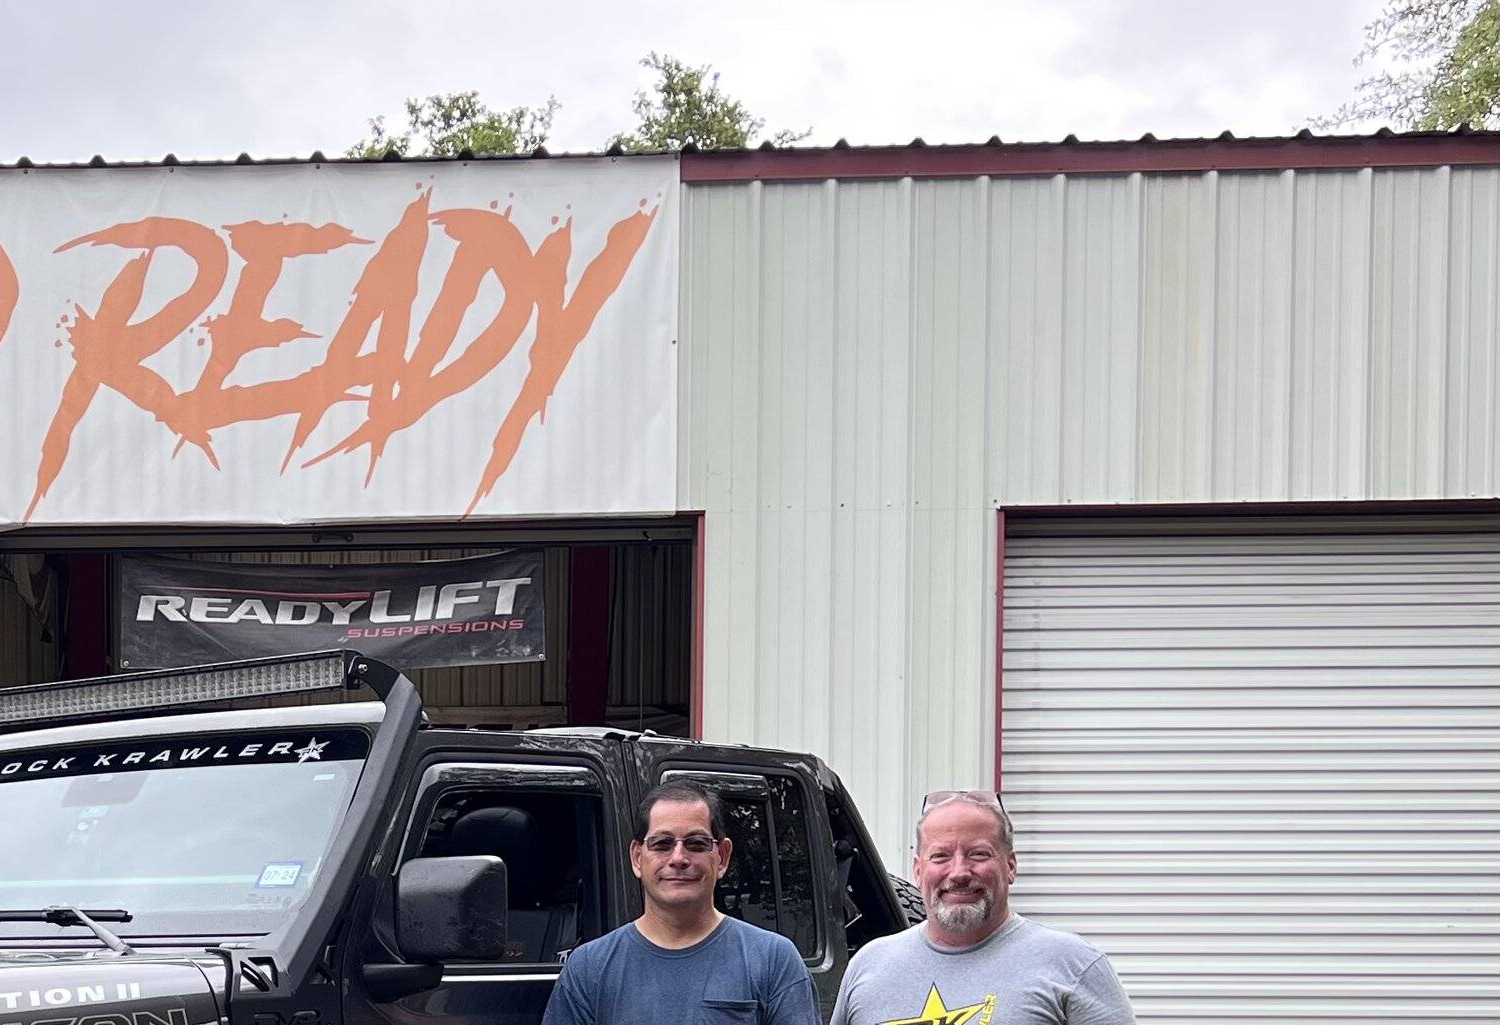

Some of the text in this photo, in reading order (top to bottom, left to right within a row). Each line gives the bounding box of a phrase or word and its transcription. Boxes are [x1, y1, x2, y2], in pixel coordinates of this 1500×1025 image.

[24, 185, 665, 522] READY
[136, 577, 532, 625] READYLIFT
[347, 619, 525, 639] SUSPENSIONS
[93, 741, 293, 767] KRAWLER
[116, 983, 141, 998] II
